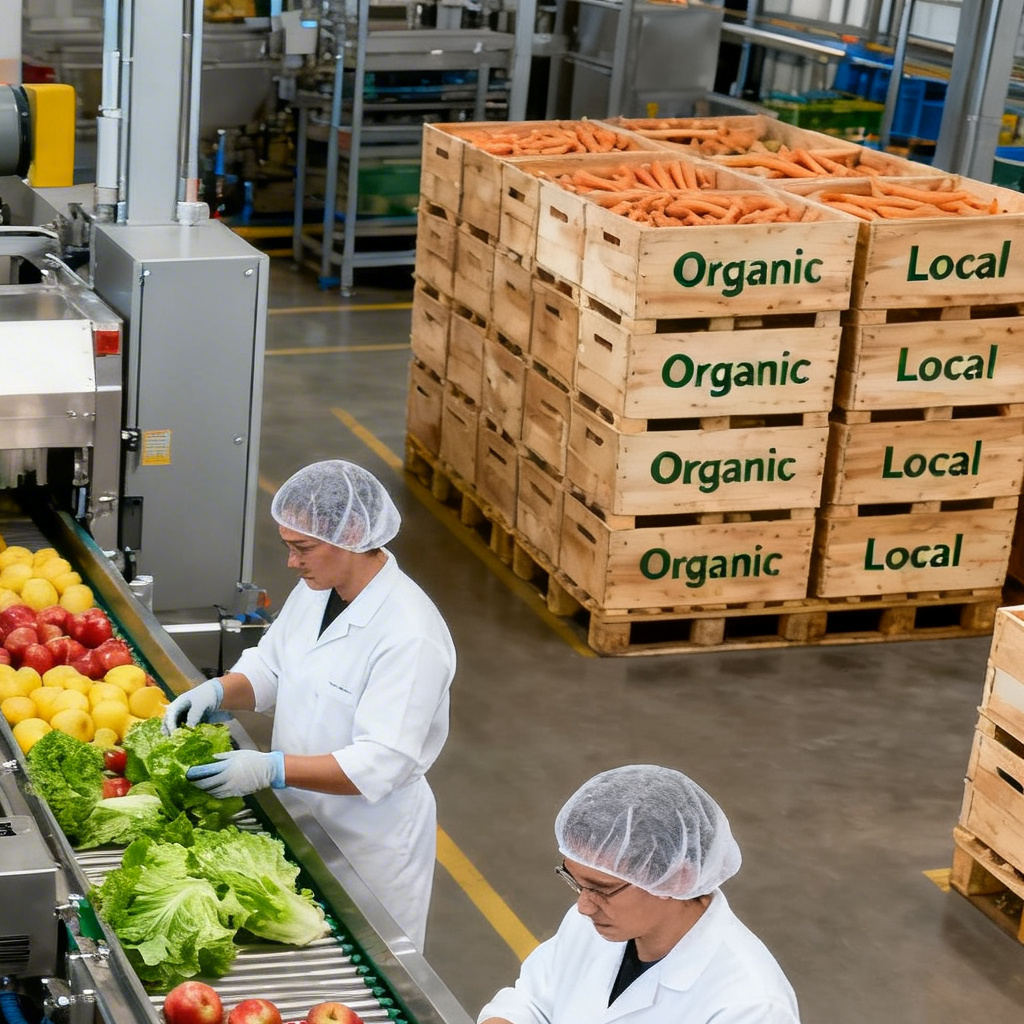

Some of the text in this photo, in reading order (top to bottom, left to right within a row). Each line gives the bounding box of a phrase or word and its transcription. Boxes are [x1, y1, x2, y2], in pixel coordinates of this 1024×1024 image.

[673, 248, 824, 297] Organic
[907, 240, 1012, 283] Local
[661, 350, 812, 397] Organic
[897, 344, 999, 382] Local
[650, 447, 797, 493] Organic
[883, 440, 983, 478] Local
[640, 544, 783, 588] Organic
[864, 533, 963, 571] Local
